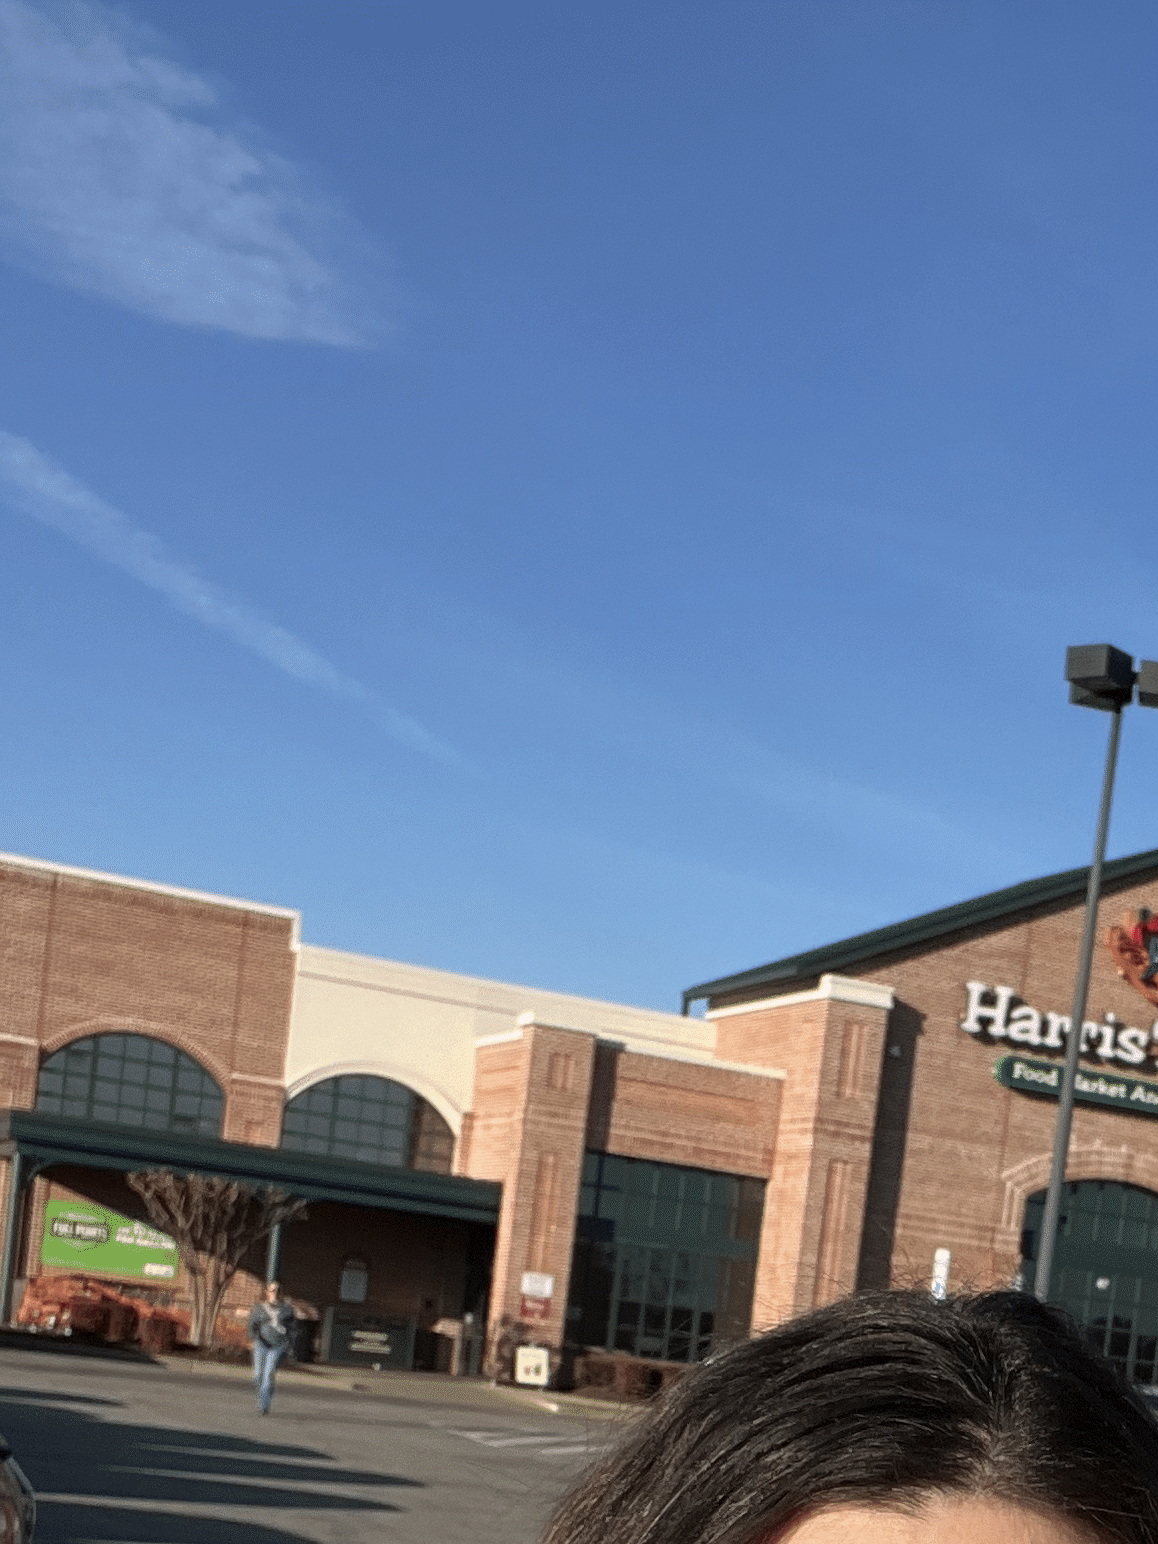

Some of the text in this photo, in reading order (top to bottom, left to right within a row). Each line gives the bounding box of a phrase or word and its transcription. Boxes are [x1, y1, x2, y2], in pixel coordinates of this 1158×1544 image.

[961, 980, 1150, 1065] Harris
[1013, 1062, 1058, 1086] Food
[1074, 1074, 1127, 1098] arket
